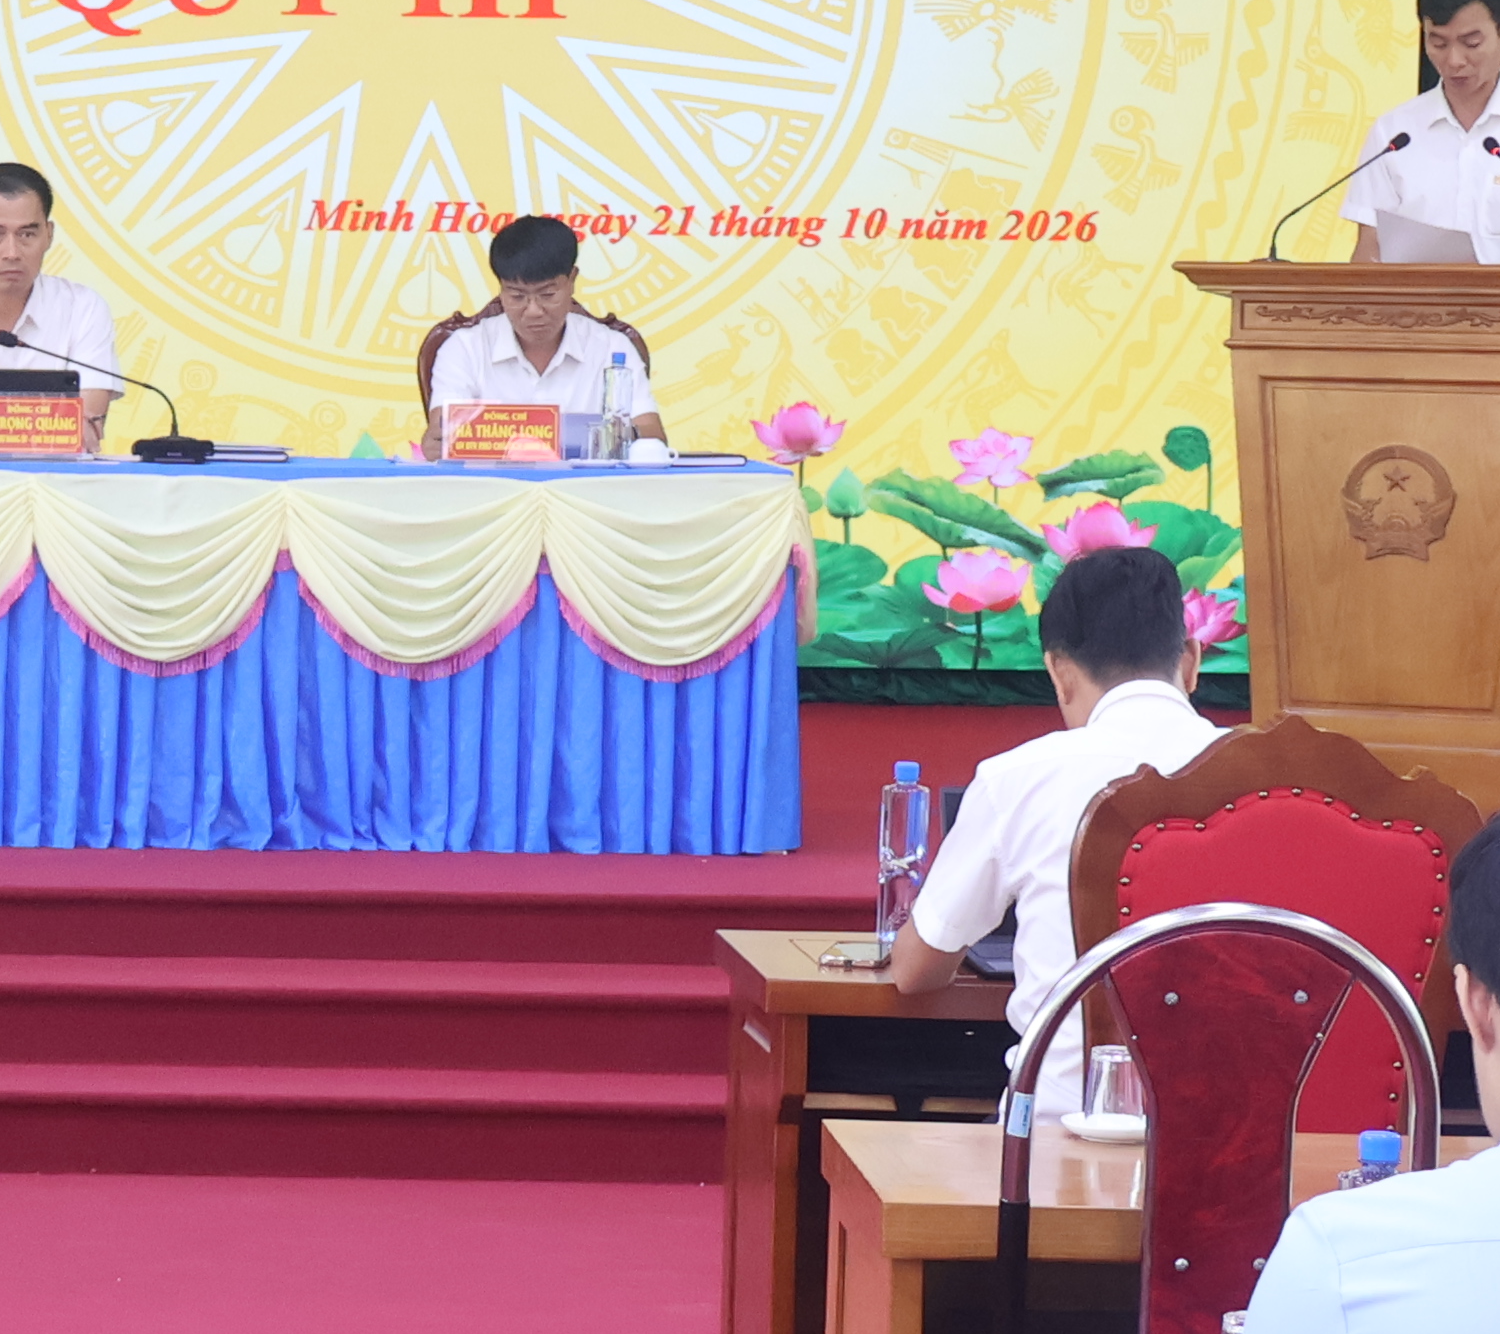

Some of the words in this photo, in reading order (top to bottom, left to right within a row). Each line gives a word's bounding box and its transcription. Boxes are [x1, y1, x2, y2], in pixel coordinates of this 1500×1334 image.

[304, 199, 415, 233] Minh
[648, 205, 697, 236] 21
[709, 205, 828, 247] tháng
[838, 207, 889, 240] 10
[899, 209, 989, 242] năm
[999, 209, 1100, 243] 2026
